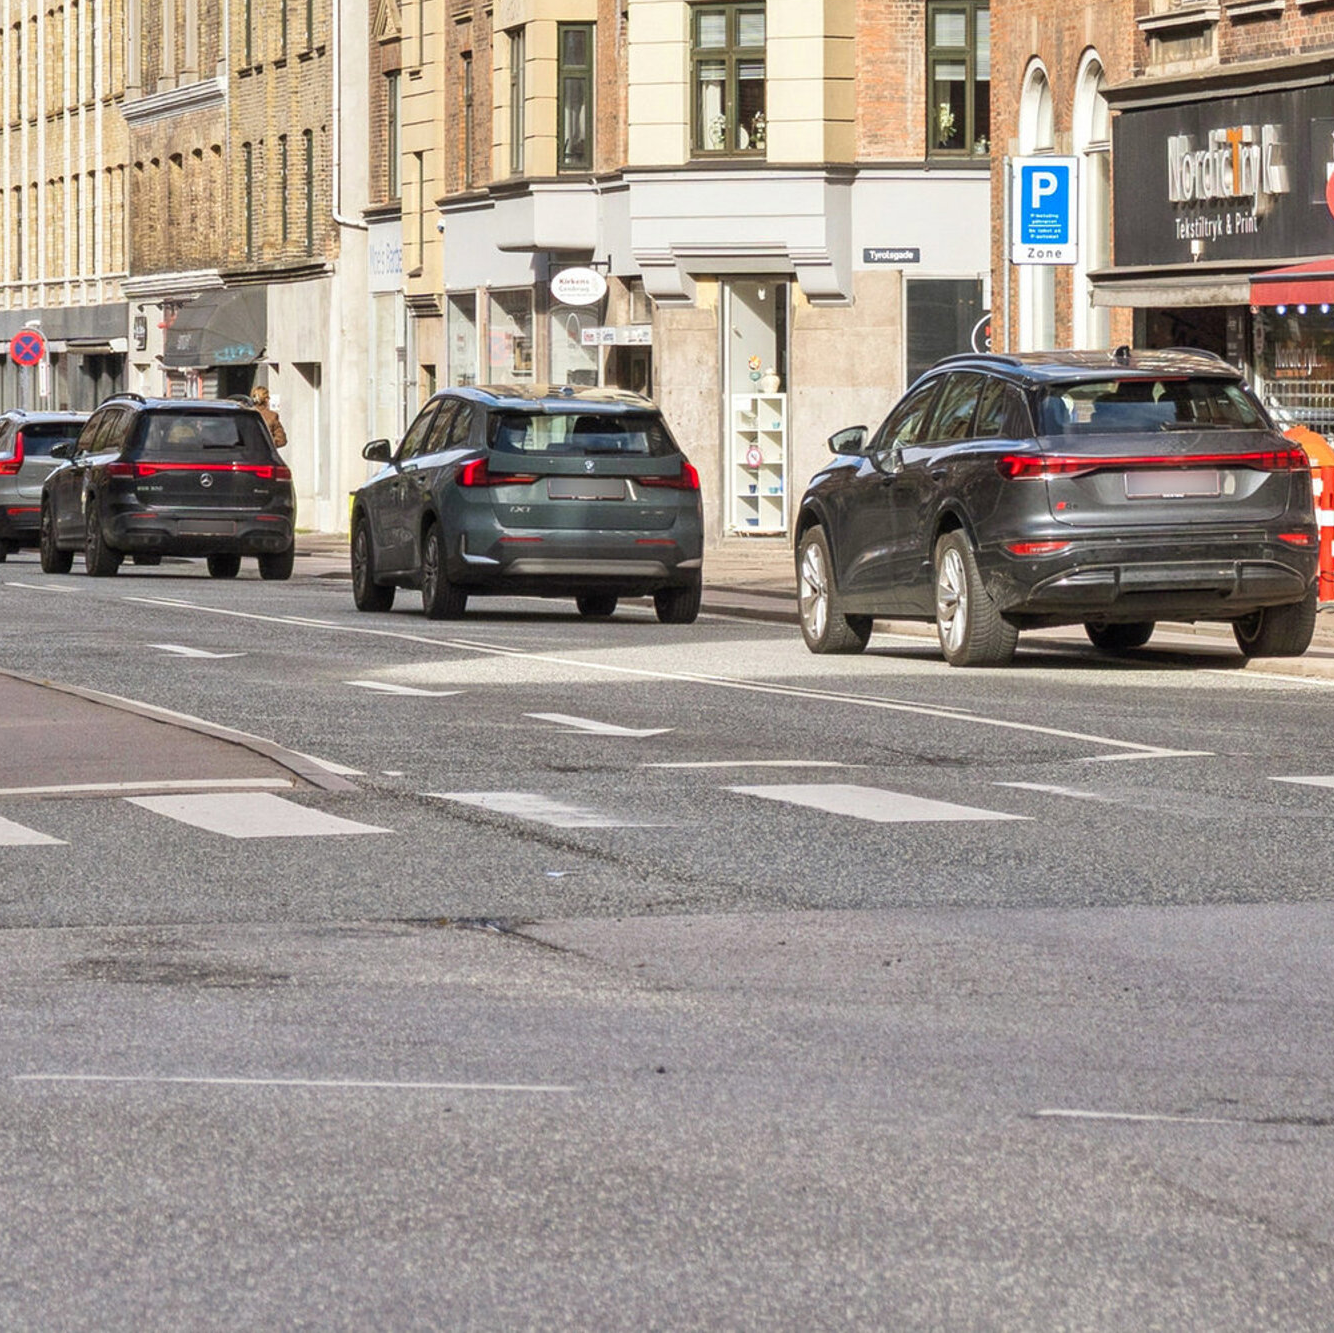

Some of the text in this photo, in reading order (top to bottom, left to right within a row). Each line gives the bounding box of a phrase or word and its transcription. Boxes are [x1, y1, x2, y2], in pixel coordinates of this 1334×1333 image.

[1032, 171, 1058, 209] P
[1175, 212, 1259, 242] Tekstiltryk & Print
[1027, 247, 1062, 259] Zone
